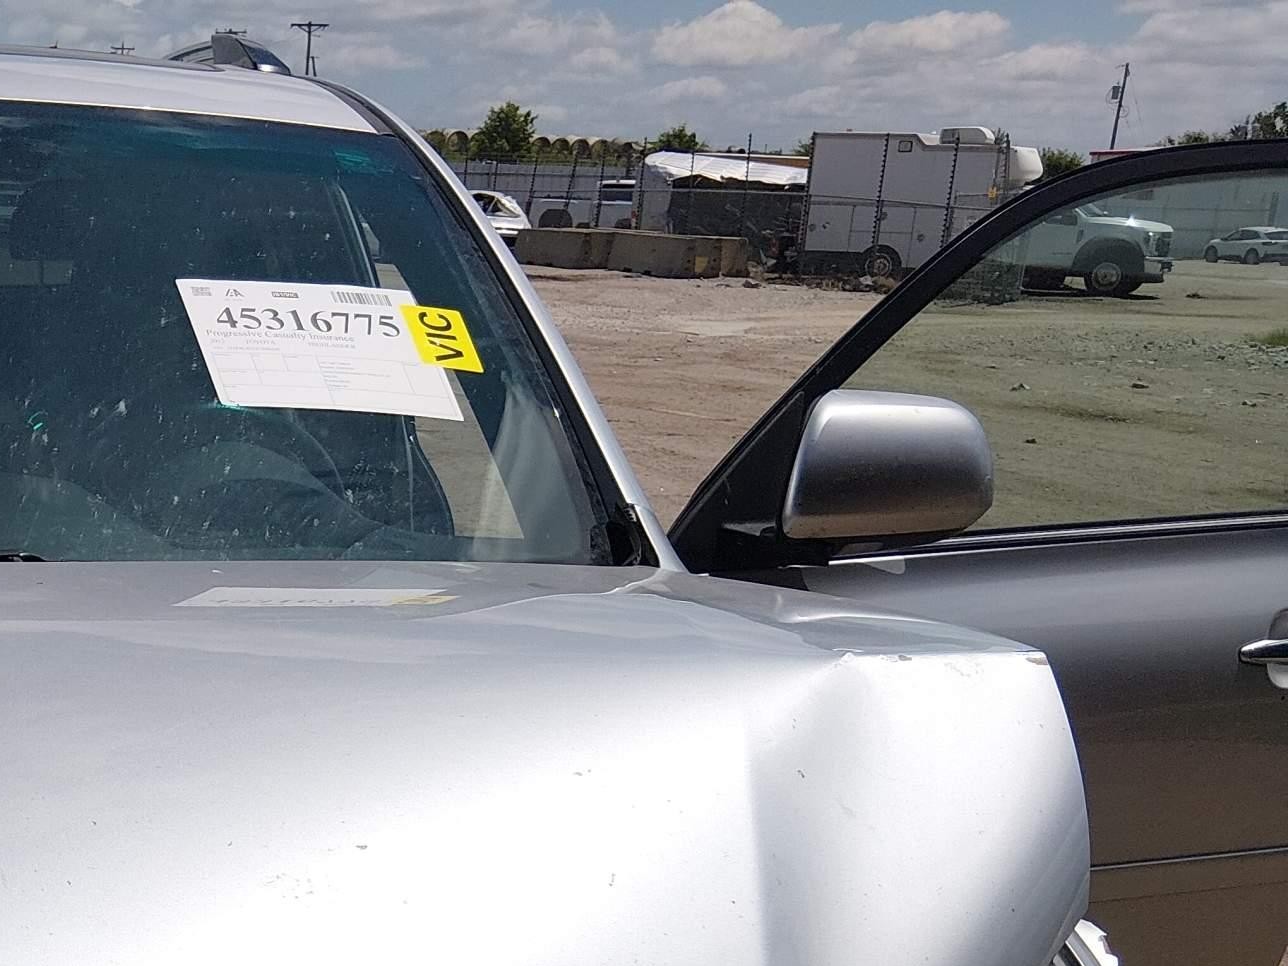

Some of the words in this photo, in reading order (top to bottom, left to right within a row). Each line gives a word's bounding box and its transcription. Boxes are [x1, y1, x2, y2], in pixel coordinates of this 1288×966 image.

[206, 329, 262, 338] Progressive
[264, 331, 306, 340] Casualty
[308, 332, 355, 342] Insurance
[216, 306, 401, 338] 45316775
[418, 311, 464, 361] VIC
